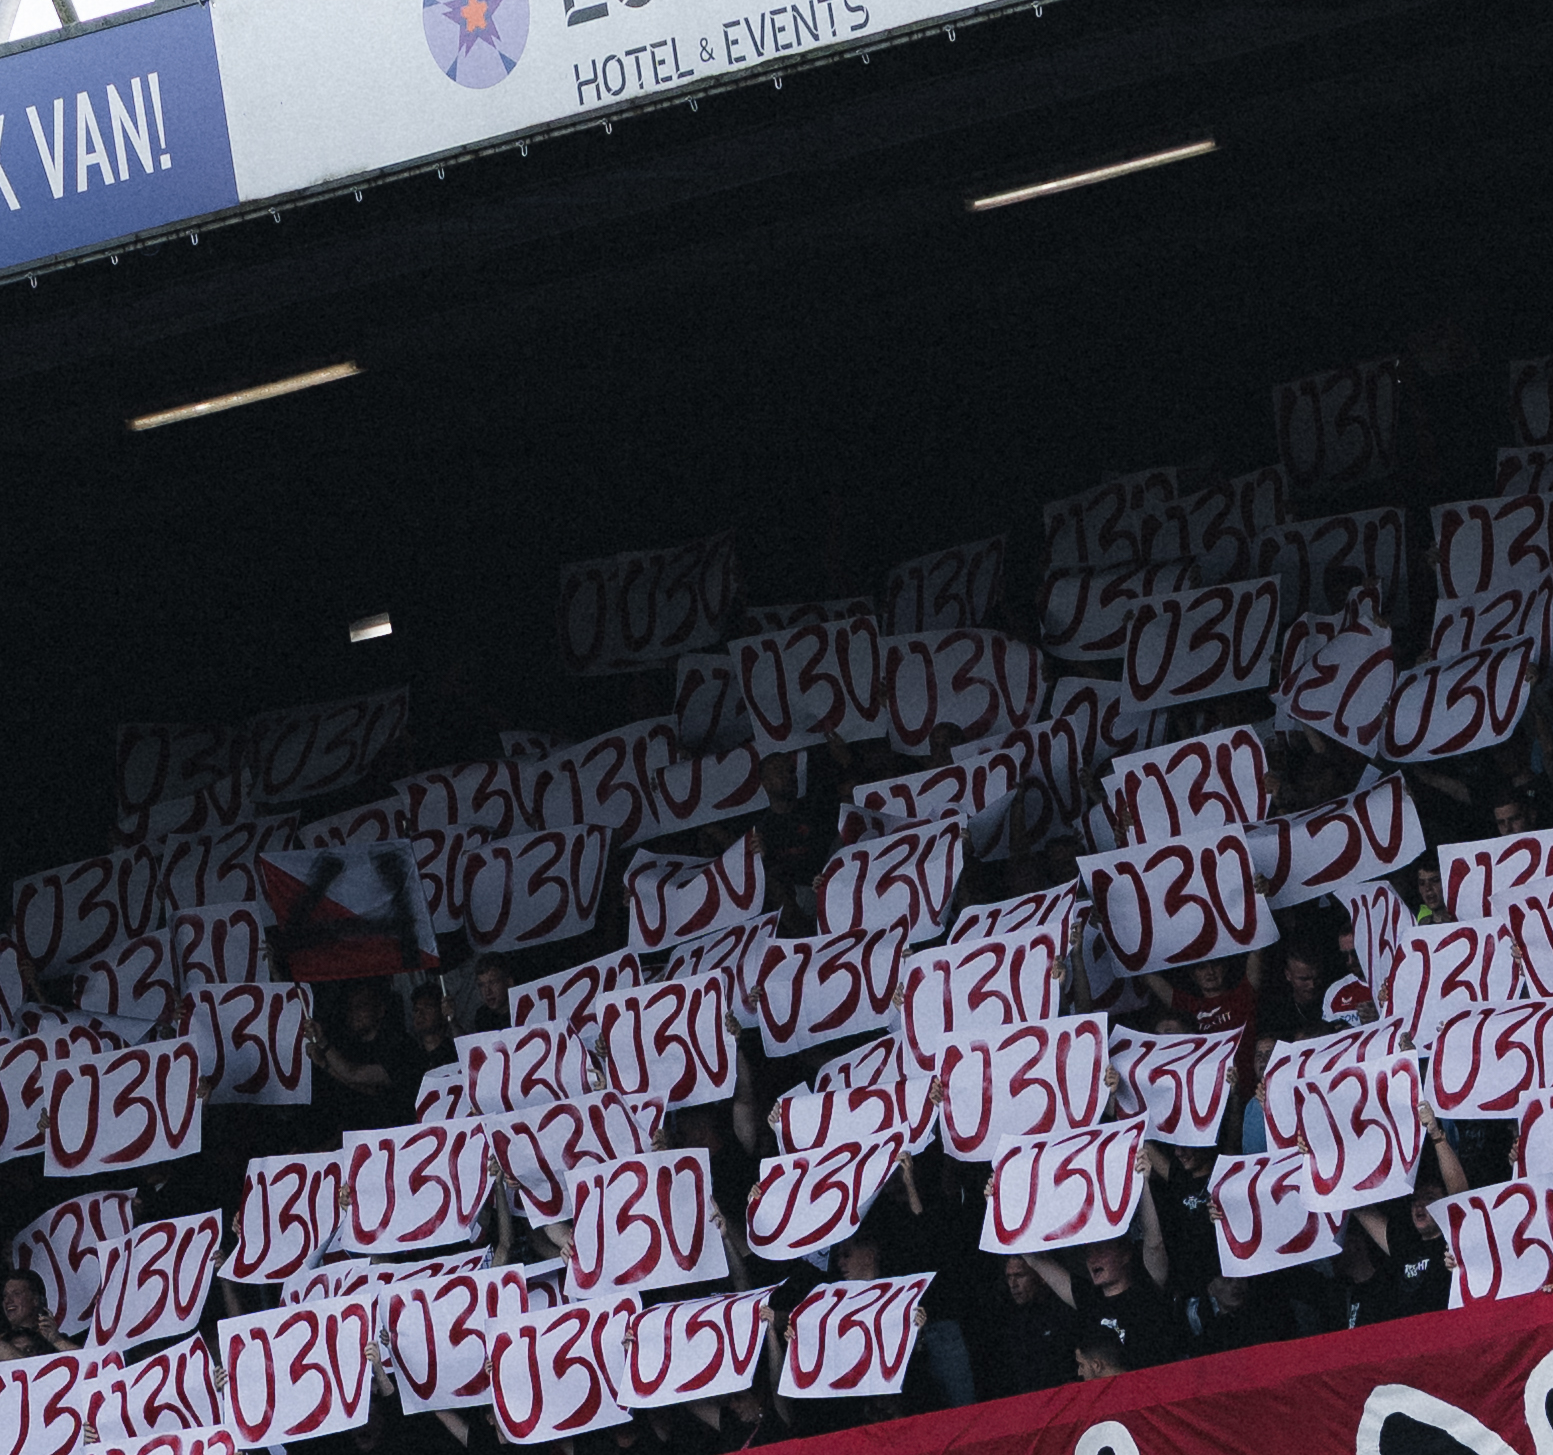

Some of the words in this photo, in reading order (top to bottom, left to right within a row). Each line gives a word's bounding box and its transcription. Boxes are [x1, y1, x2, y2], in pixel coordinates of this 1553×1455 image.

[574, 36, 696, 106] HOTEL
[698, 36, 716, 64] &
[26, 71, 173, 199] VAN!
